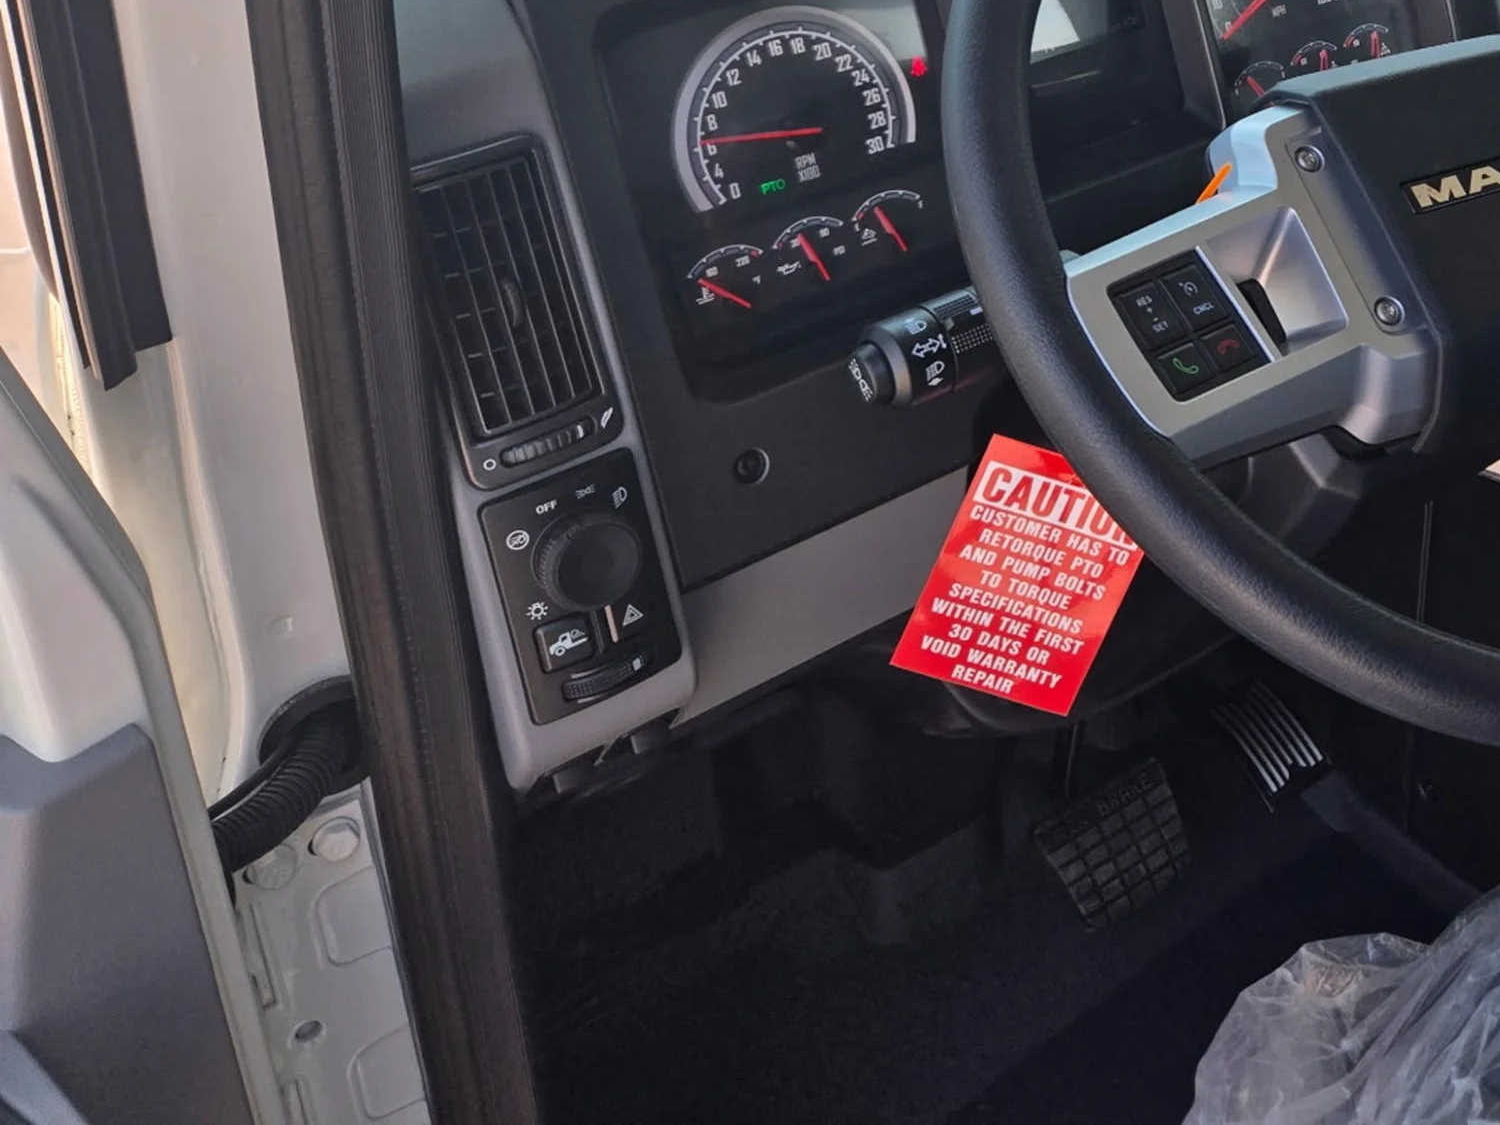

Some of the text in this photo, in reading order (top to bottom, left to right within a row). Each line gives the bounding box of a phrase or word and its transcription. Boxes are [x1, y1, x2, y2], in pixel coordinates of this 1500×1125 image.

[1271, 4, 1287, 17] MPH
[768, 39, 783, 57] 16
[790, 37, 805, 55] 18
[813, 42, 832, 61] 20
[746, 50, 762, 67] 14
[834, 54, 853, 72] 22
[726, 69, 742, 86] 12
[852, 69, 870, 86] 24
[713, 91, 728, 109] 10
[862, 88, 881, 106] 26
[707, 115, 718, 131] 8
[868, 111, 886, 129] 28
[865, 136, 884, 155] 30
[795, 153, 816, 168] RPM
[714, 163, 724, 179] 4
[729, 183, 741, 199] 0
[759, 179, 786, 195] PTO
[1136, 296, 1152, 307] RES
[1152, 321, 1169, 333] SET
[535, 500, 558, 515] OFF
[969, 505, 1130, 567] CUSTOMER HAS TO
[978, 528, 1104, 578] RETORQUE PTO
[959, 544, 1107, 600] AND PUMP BOLTS
[980, 569, 1073, 611] TO TORQUE
[949, 582, 1084, 634] SPECIFICATIONS
[931, 597, 1084, 656] WITHIN THE FIRST
[948, 624, 1051, 666] 30 DAYS OR
[920, 635, 1062, 689] VOID WARRANTY
[951, 664, 1015, 695] REPAIR
